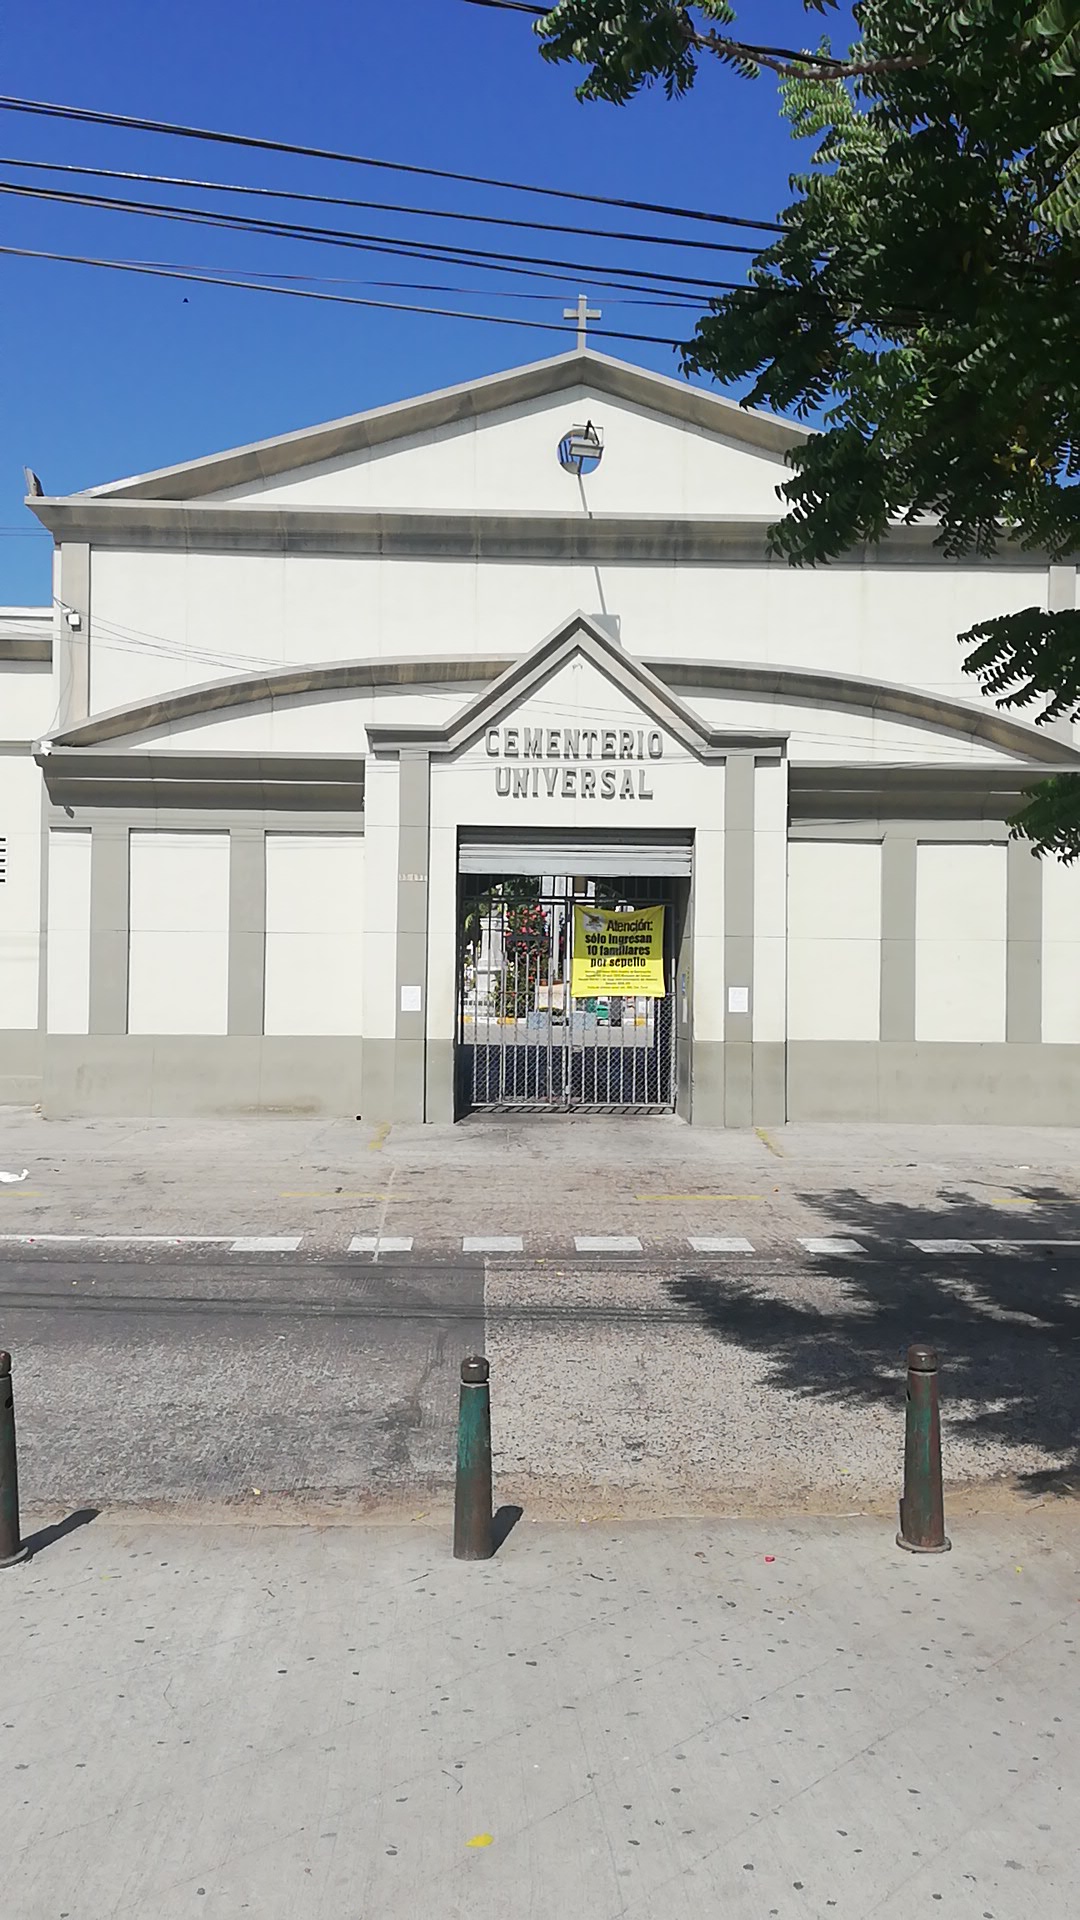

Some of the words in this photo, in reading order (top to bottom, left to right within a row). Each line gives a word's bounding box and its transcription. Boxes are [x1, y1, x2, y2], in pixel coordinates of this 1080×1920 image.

[485, 726, 663, 760] CEMENTERIO
[495, 767, 654, 800] UNIVERSAL
[606, 919, 653, 932] Atención:
[585, 933, 606, 944] sólo
[587, 945, 598, 955] 10
[599, 945, 650, 956] familiares
[590, 958, 606, 967] por
